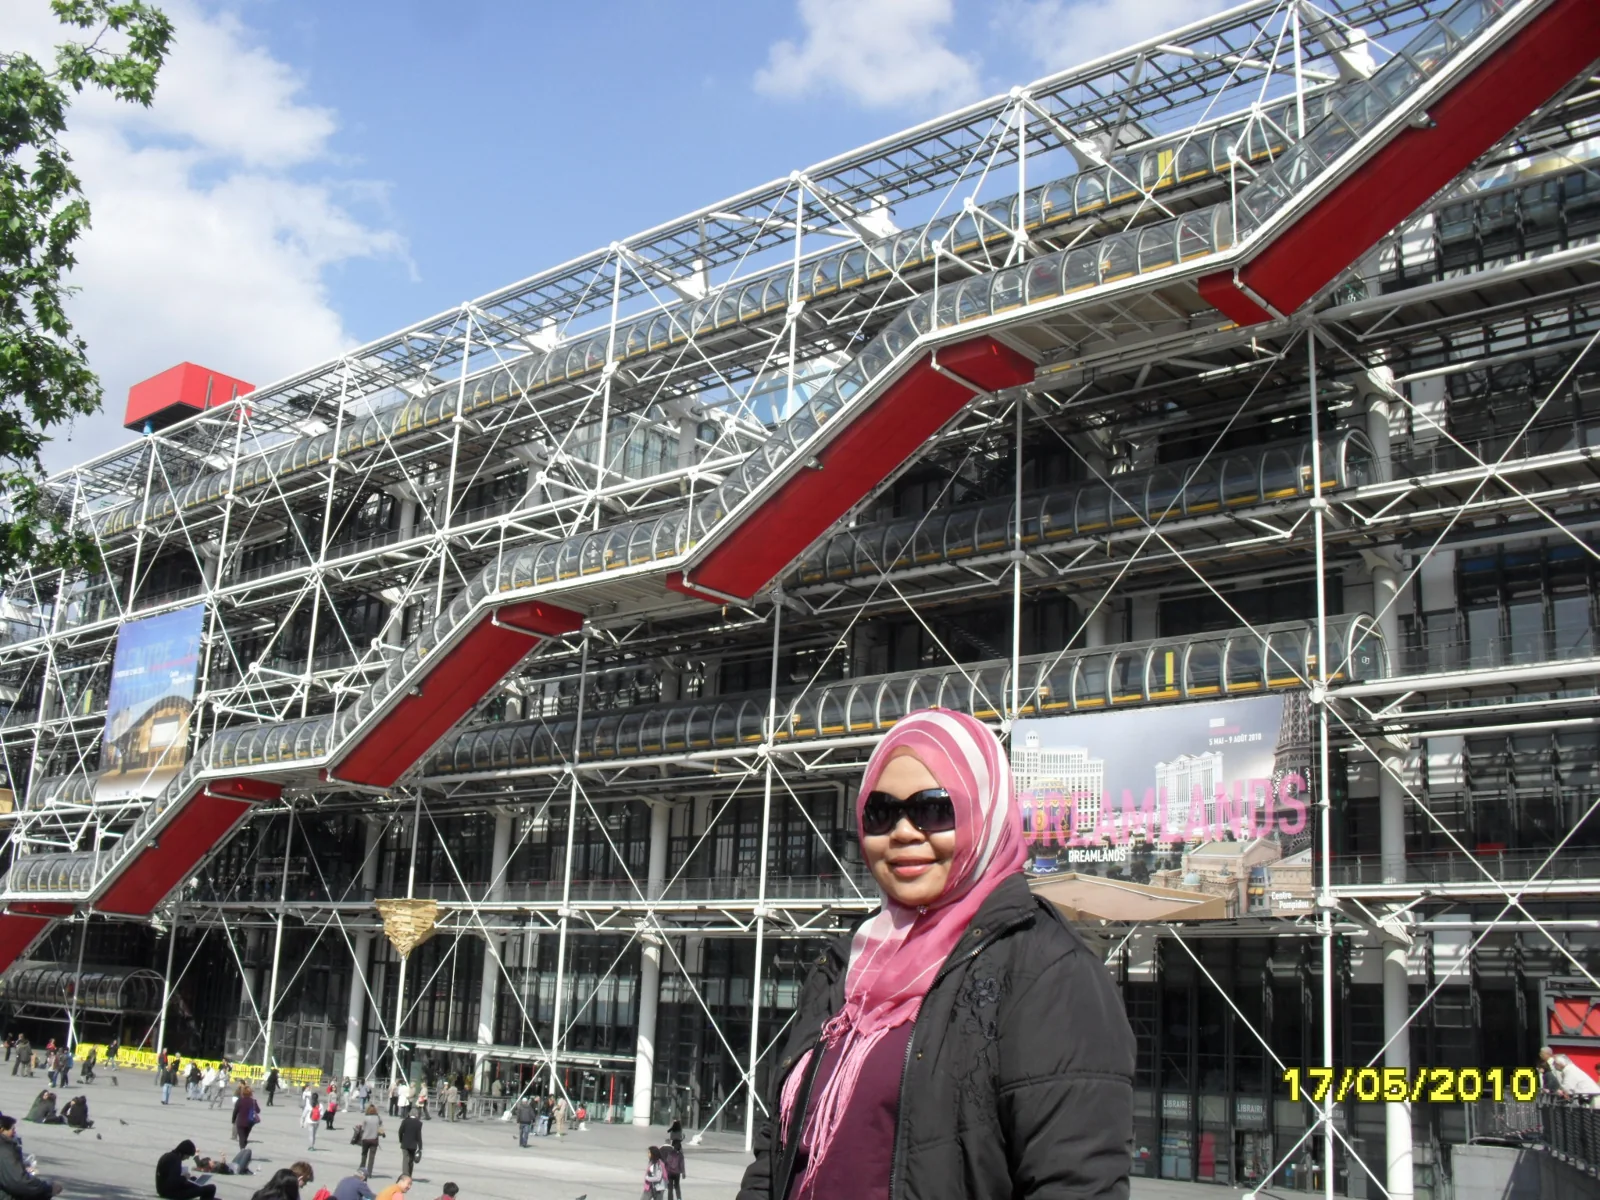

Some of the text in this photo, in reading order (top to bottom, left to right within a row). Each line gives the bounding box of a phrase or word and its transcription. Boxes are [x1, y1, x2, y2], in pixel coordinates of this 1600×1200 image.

[1019, 773, 1307, 848] DREAMLANDS
[1068, 849, 1126, 862] DREAMLANDS
[1271, 892, 1292, 900] Centre
[1279, 900, 1309, 910] Pompidou
